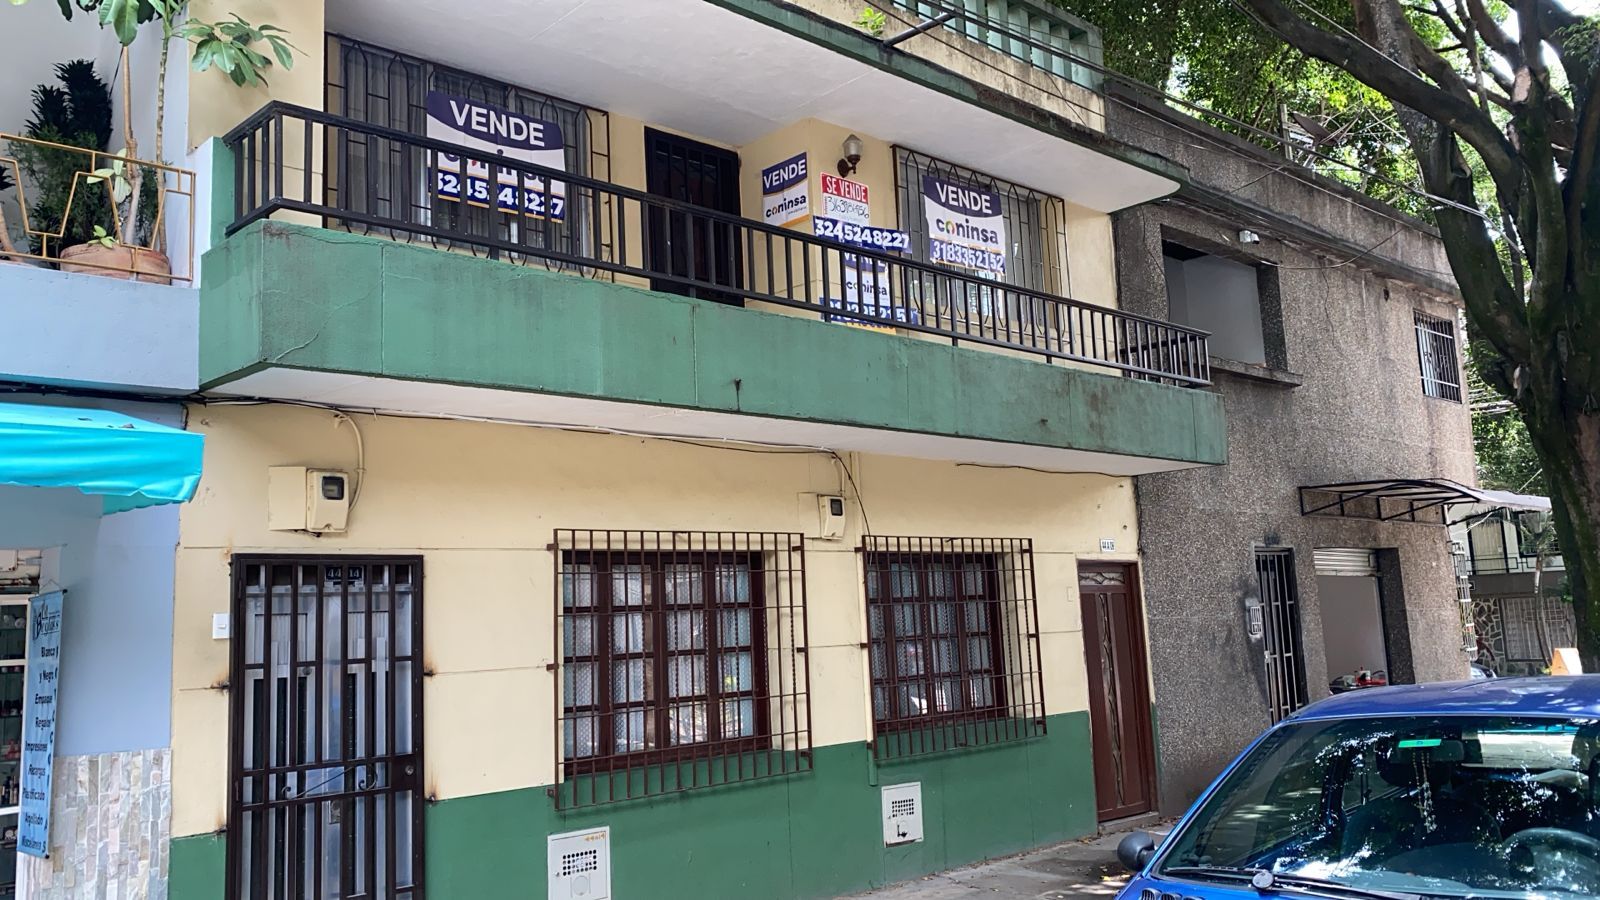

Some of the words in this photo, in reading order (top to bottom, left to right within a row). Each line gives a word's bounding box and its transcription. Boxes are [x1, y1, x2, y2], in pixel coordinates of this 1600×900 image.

[450, 100, 545, 147] VENDE
[763, 159, 807, 189] VENDE
[826, 176, 838, 194] SE
[839, 179, 867, 202] VENDE
[766, 195, 807, 217] coninsa
[936, 182, 993, 214] VENDE
[814, 218, 910, 249] 3245248227
[936, 217, 999, 245] coninsa
[933, 241, 1004, 271] 3183352152
